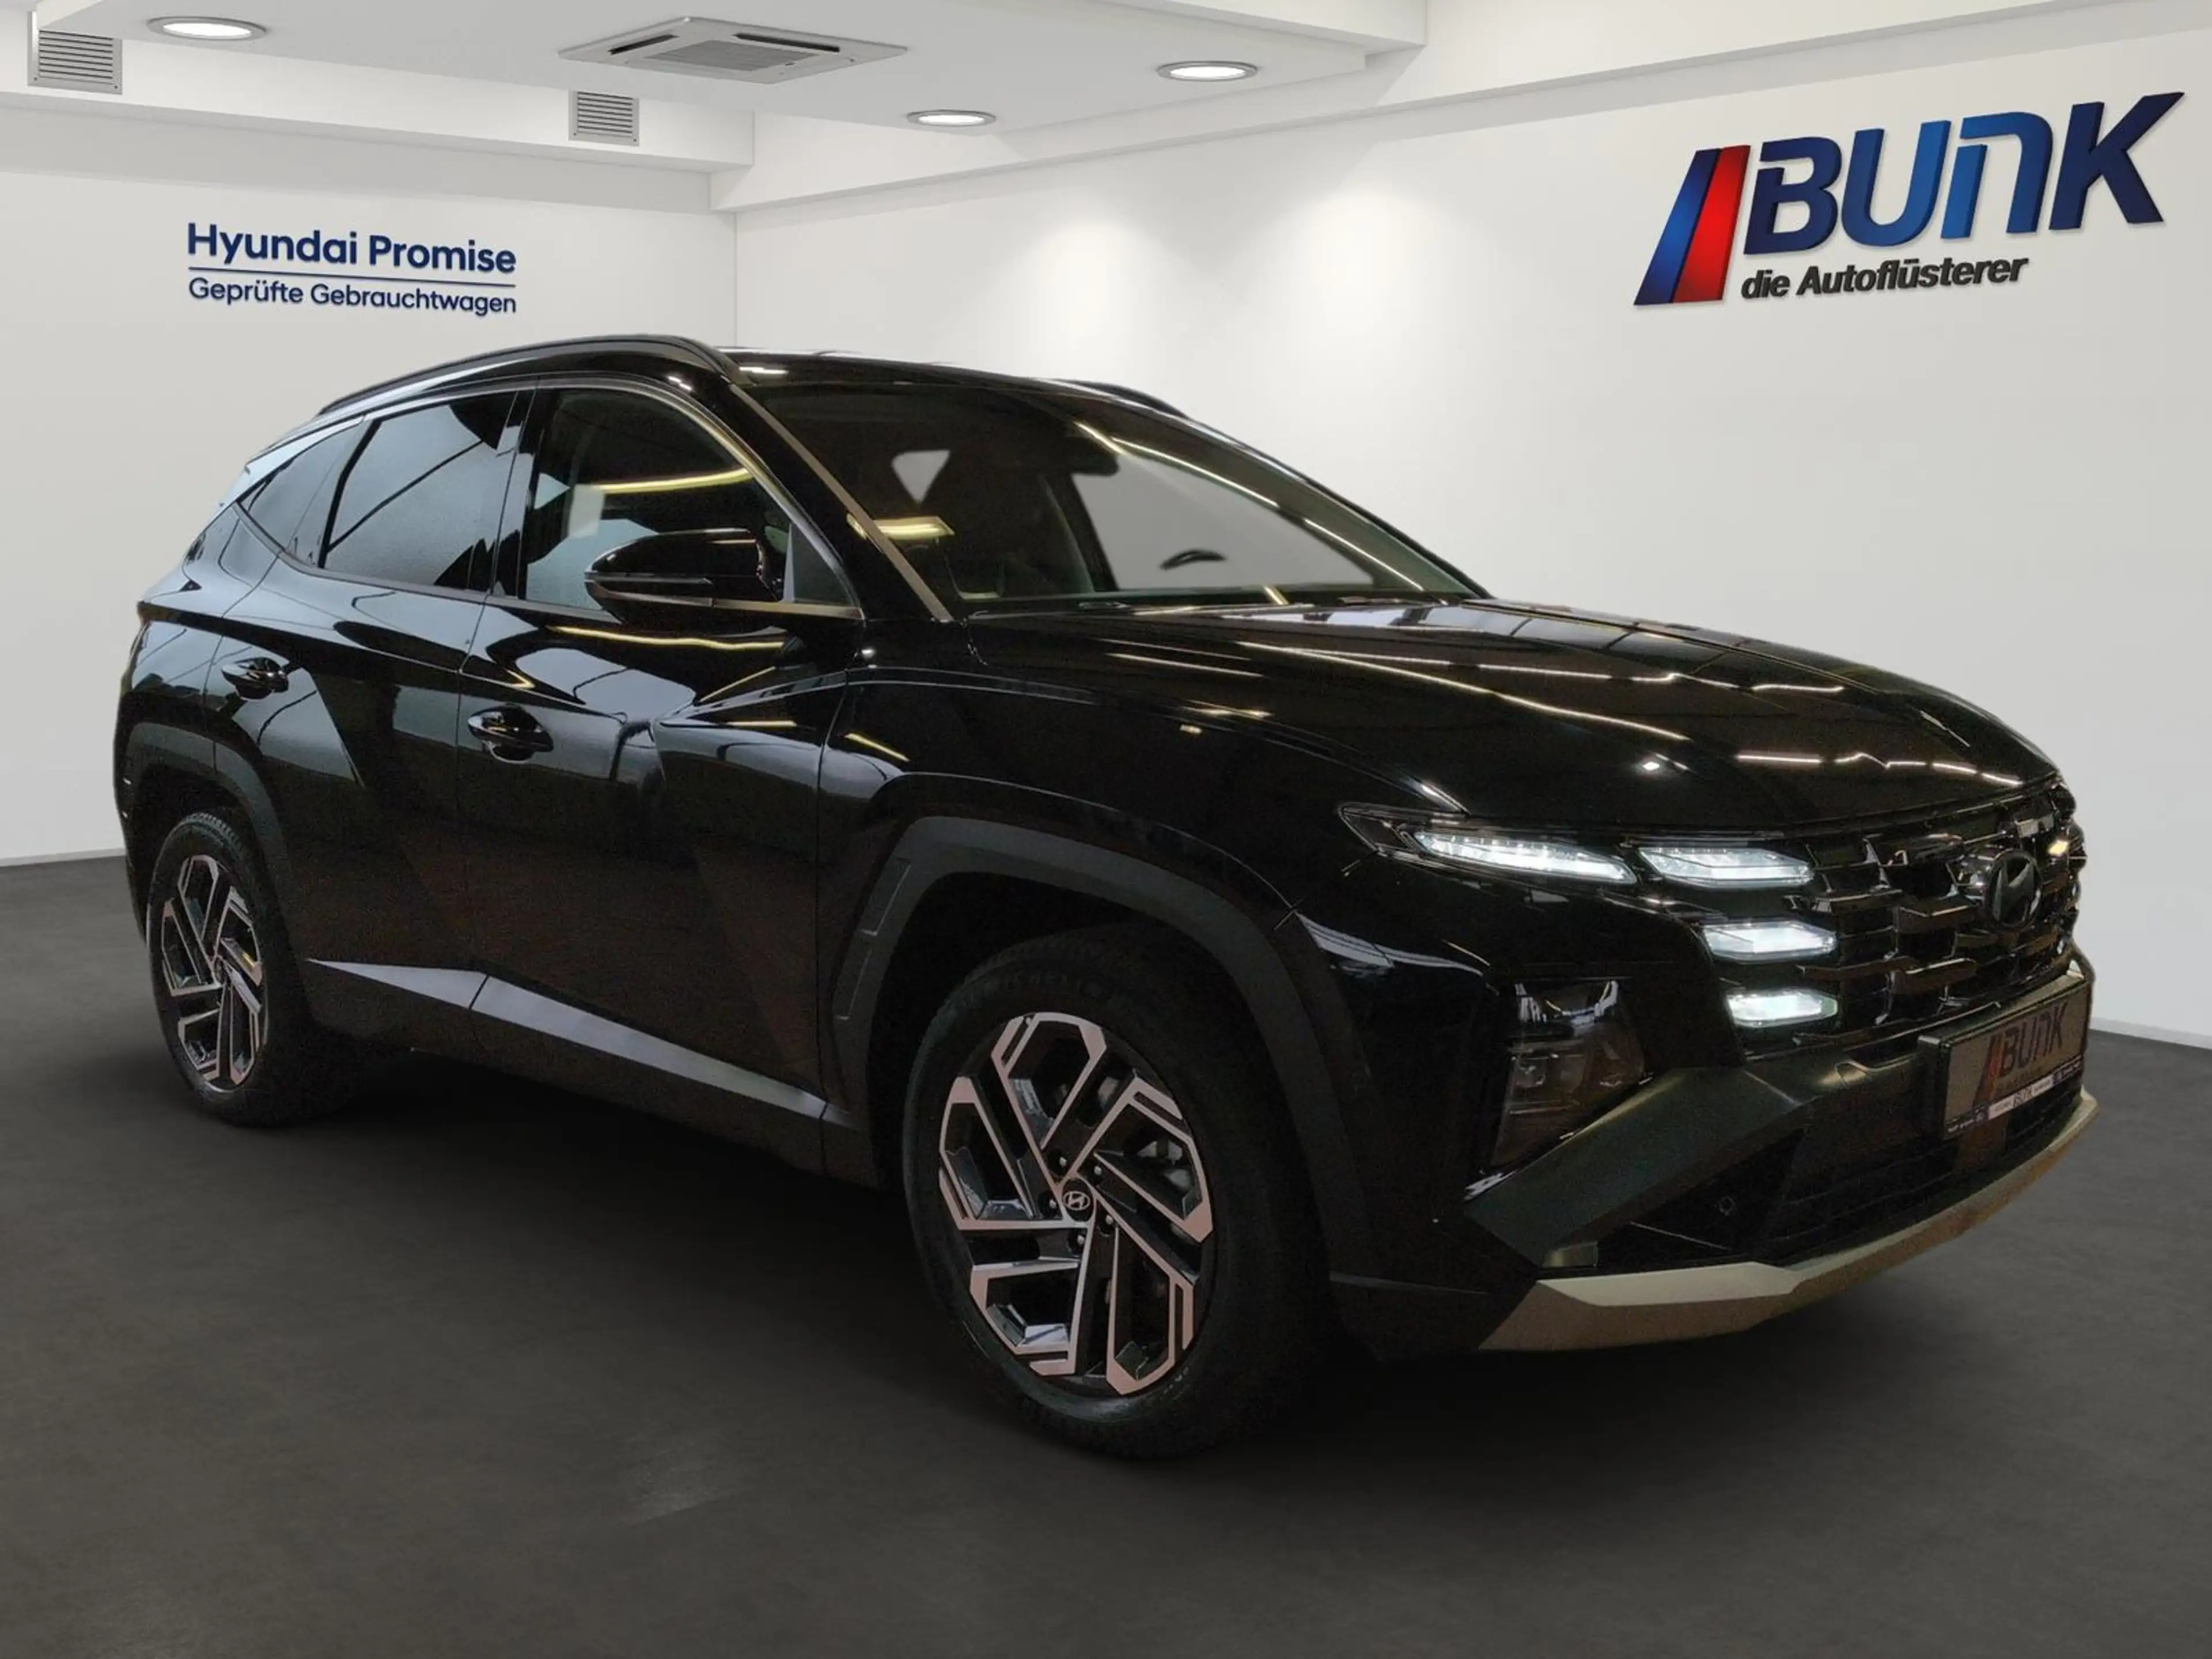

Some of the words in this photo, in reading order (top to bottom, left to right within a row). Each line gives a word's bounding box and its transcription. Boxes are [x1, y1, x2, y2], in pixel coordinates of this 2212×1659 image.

[1743, 91, 2185, 255] BUNK
[188, 222, 357, 265] Hyundai
[369, 234, 516, 274] Promise
[188, 276, 304, 305] Geprüfte
[310, 283, 516, 316] Gebrauchtwagen
[1741, 269, 1790, 300] die
[1796, 257, 2029, 296] Autoflüsterer
[2001, 999, 2069, 1077] BUNK
